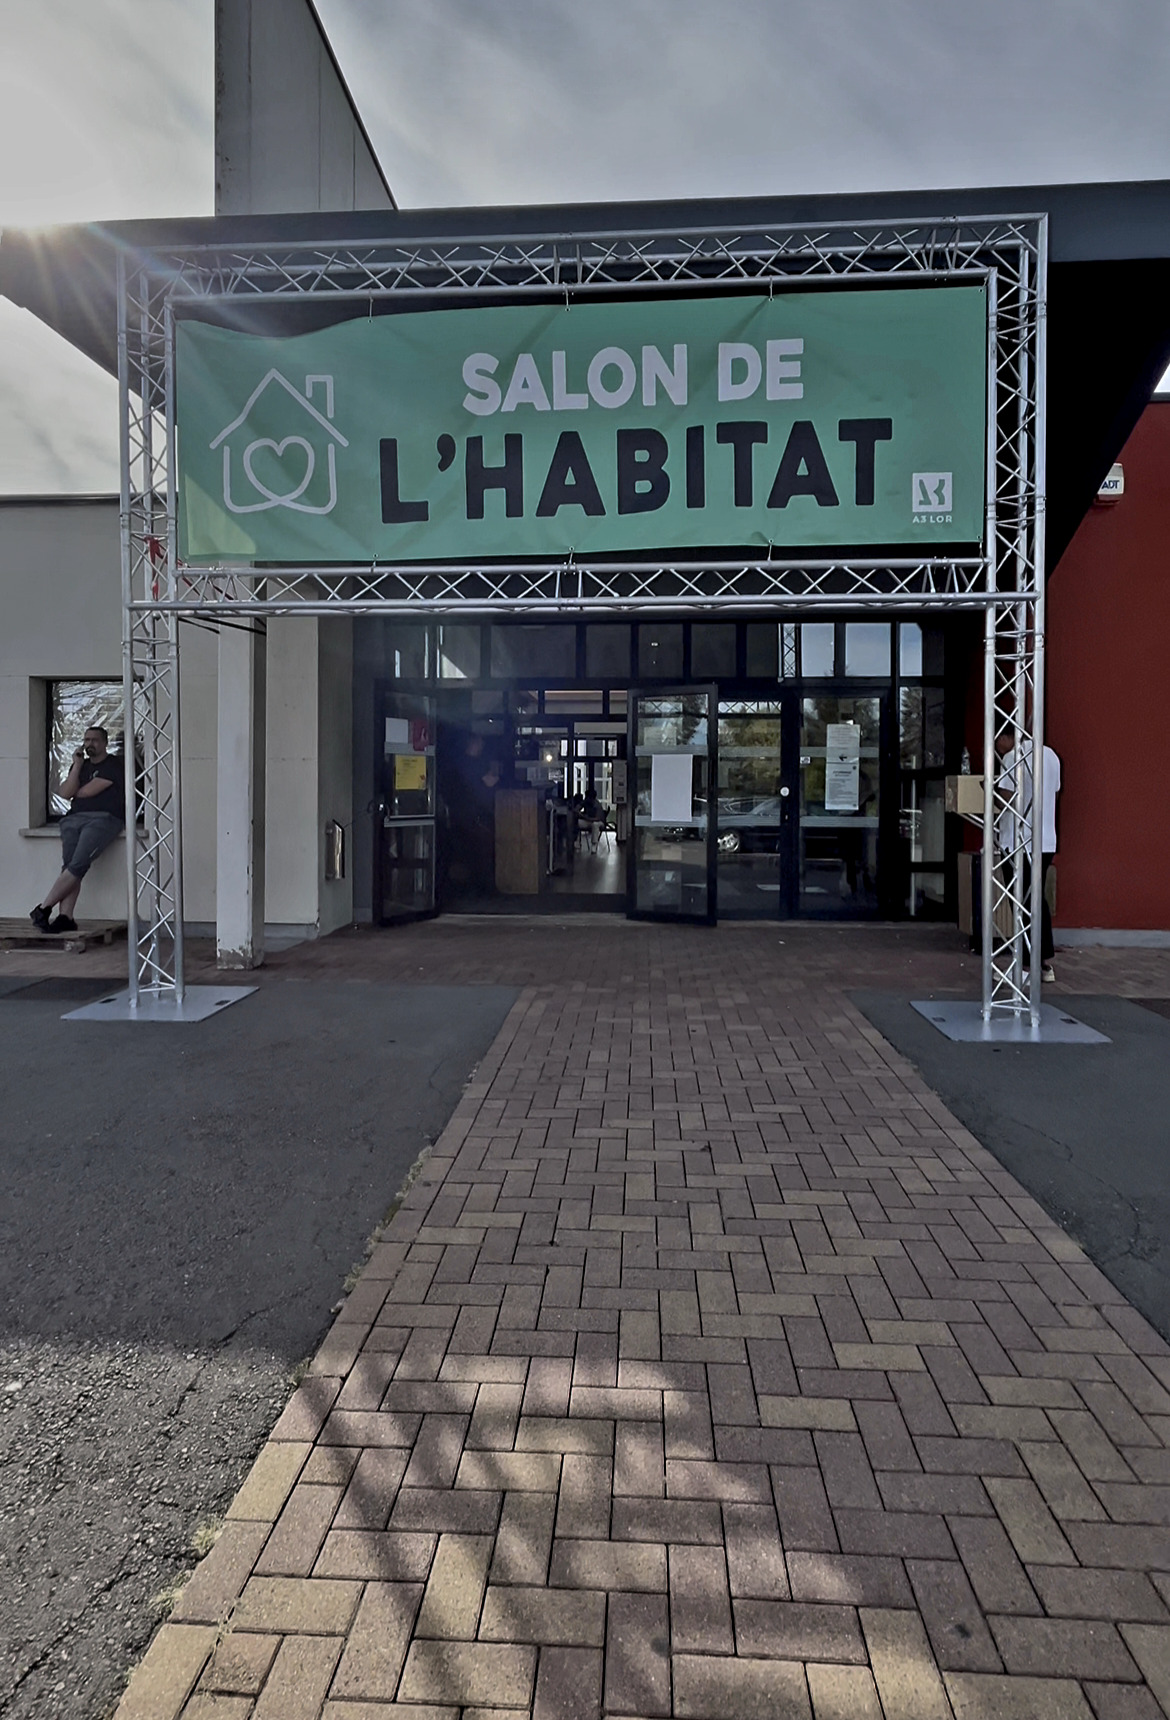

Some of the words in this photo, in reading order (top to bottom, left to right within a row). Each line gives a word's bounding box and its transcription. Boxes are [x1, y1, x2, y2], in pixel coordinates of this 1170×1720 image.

[462, 344, 688, 416] SALON
[718, 338, 804, 402] DE
[379, 418, 893, 524] L'HABITAT
[1101, 480, 1120, 490] ADT
[930, 515, 953, 523] LOR
